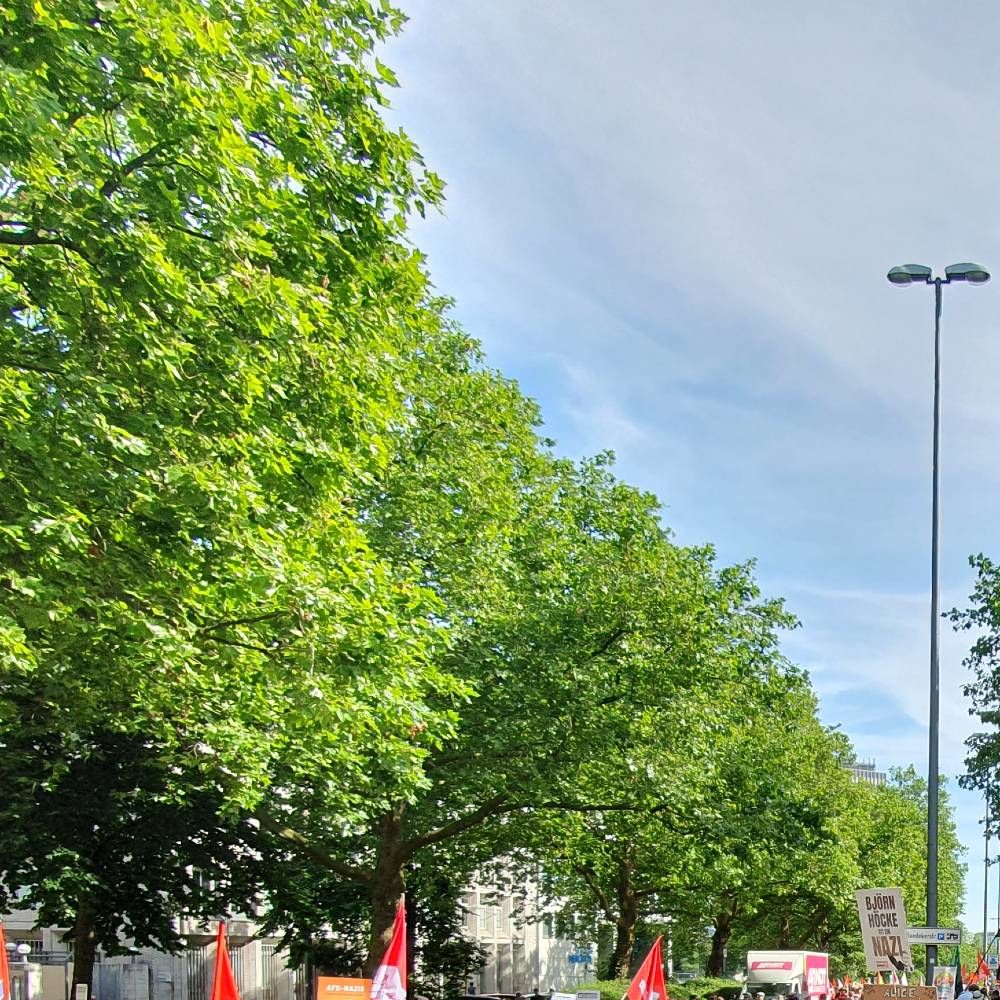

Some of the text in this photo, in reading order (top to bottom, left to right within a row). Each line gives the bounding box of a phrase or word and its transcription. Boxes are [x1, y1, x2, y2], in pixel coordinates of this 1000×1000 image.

[865, 893, 896, 911] BJÖRN
[868, 911, 898, 928] HÖCKE
[871, 936, 903, 957] NAZI
